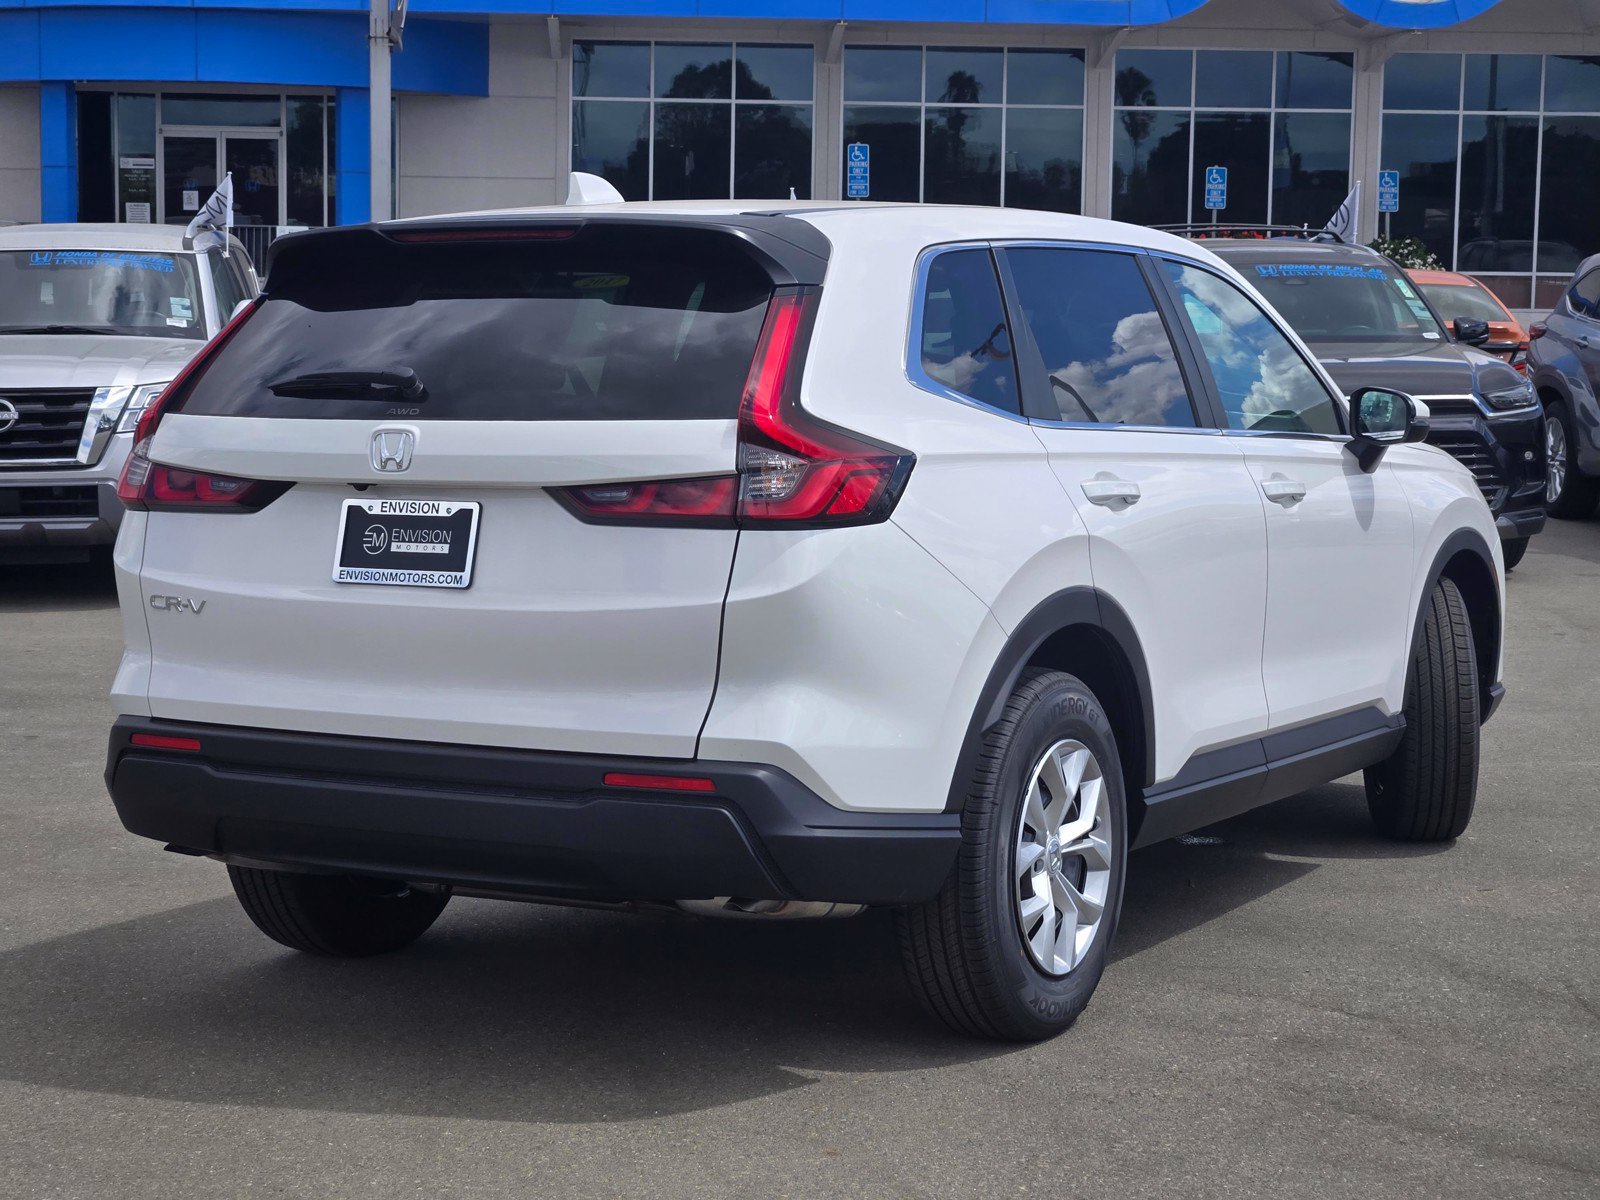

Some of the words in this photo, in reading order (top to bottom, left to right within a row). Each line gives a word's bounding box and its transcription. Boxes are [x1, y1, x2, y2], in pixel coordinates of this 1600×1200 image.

[380, 501, 440, 515] ENVISION
[391, 528, 453, 543] ENVISION
[396, 544, 445, 552] MOTORS
[338, 569, 464, 585] ENVISIONMOTORS.COM
[149, 594, 207, 615] CR-V
